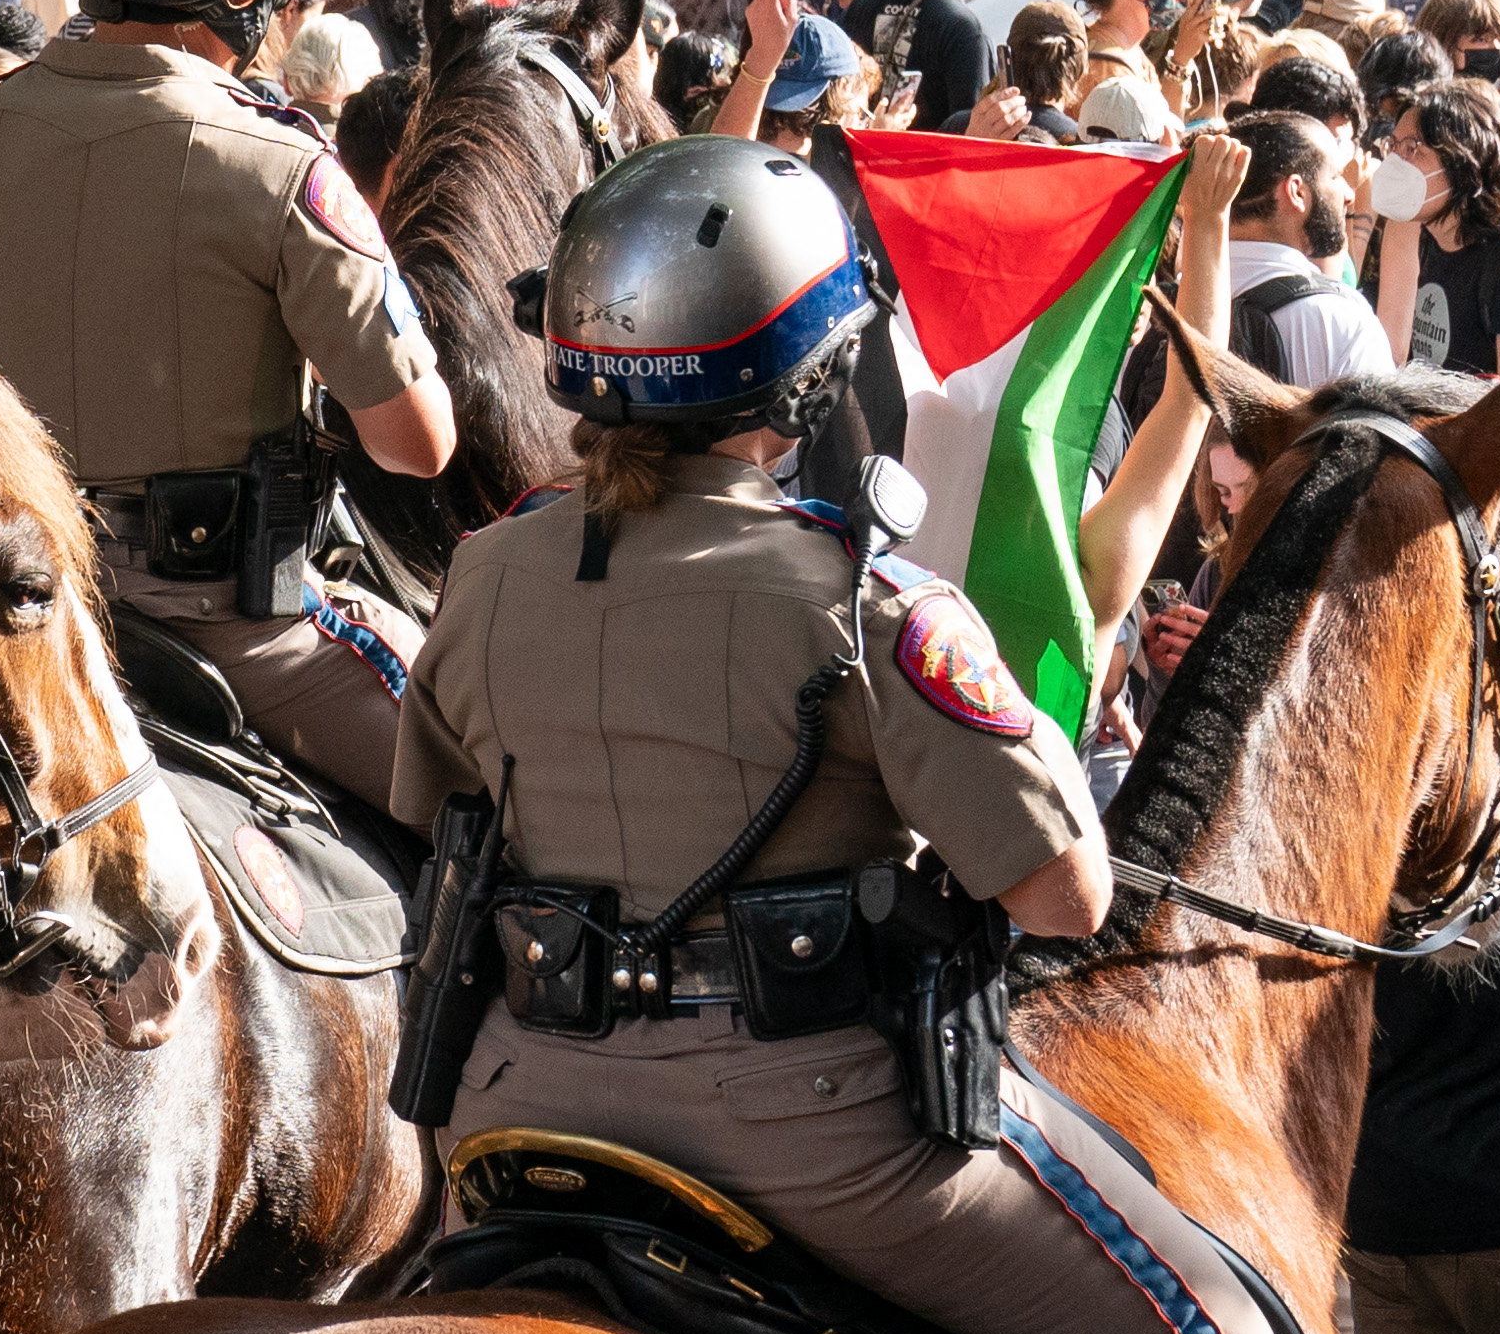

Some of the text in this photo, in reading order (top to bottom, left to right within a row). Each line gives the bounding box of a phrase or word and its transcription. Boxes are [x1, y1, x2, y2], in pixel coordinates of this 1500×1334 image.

[1422, 293, 1435, 316] the
[548, 342, 704, 377] TATE TROOPER
